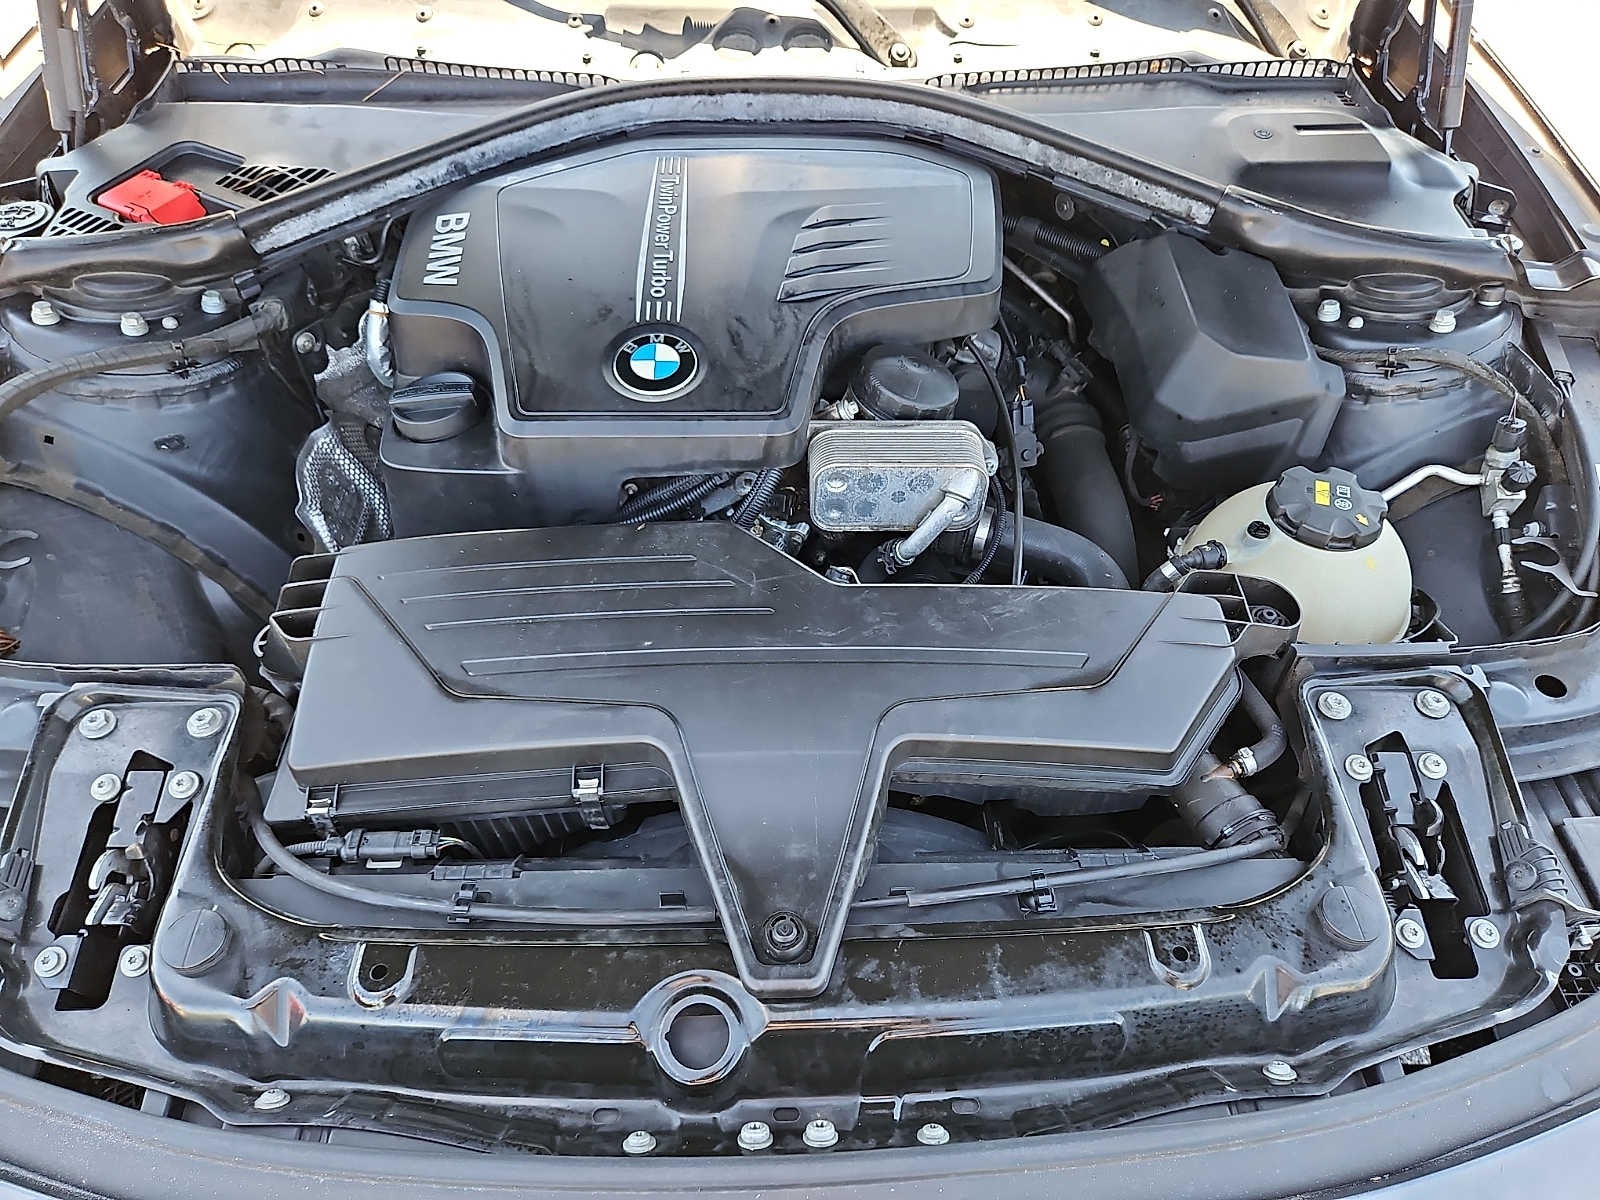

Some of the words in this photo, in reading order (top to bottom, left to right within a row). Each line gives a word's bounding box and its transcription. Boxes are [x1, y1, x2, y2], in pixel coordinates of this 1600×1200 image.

[654, 175, 681, 249] TwinPower
[423, 212, 471, 286] BMW
[649, 250, 674, 299] Turbo
[623, 334, 691, 354] BMW
